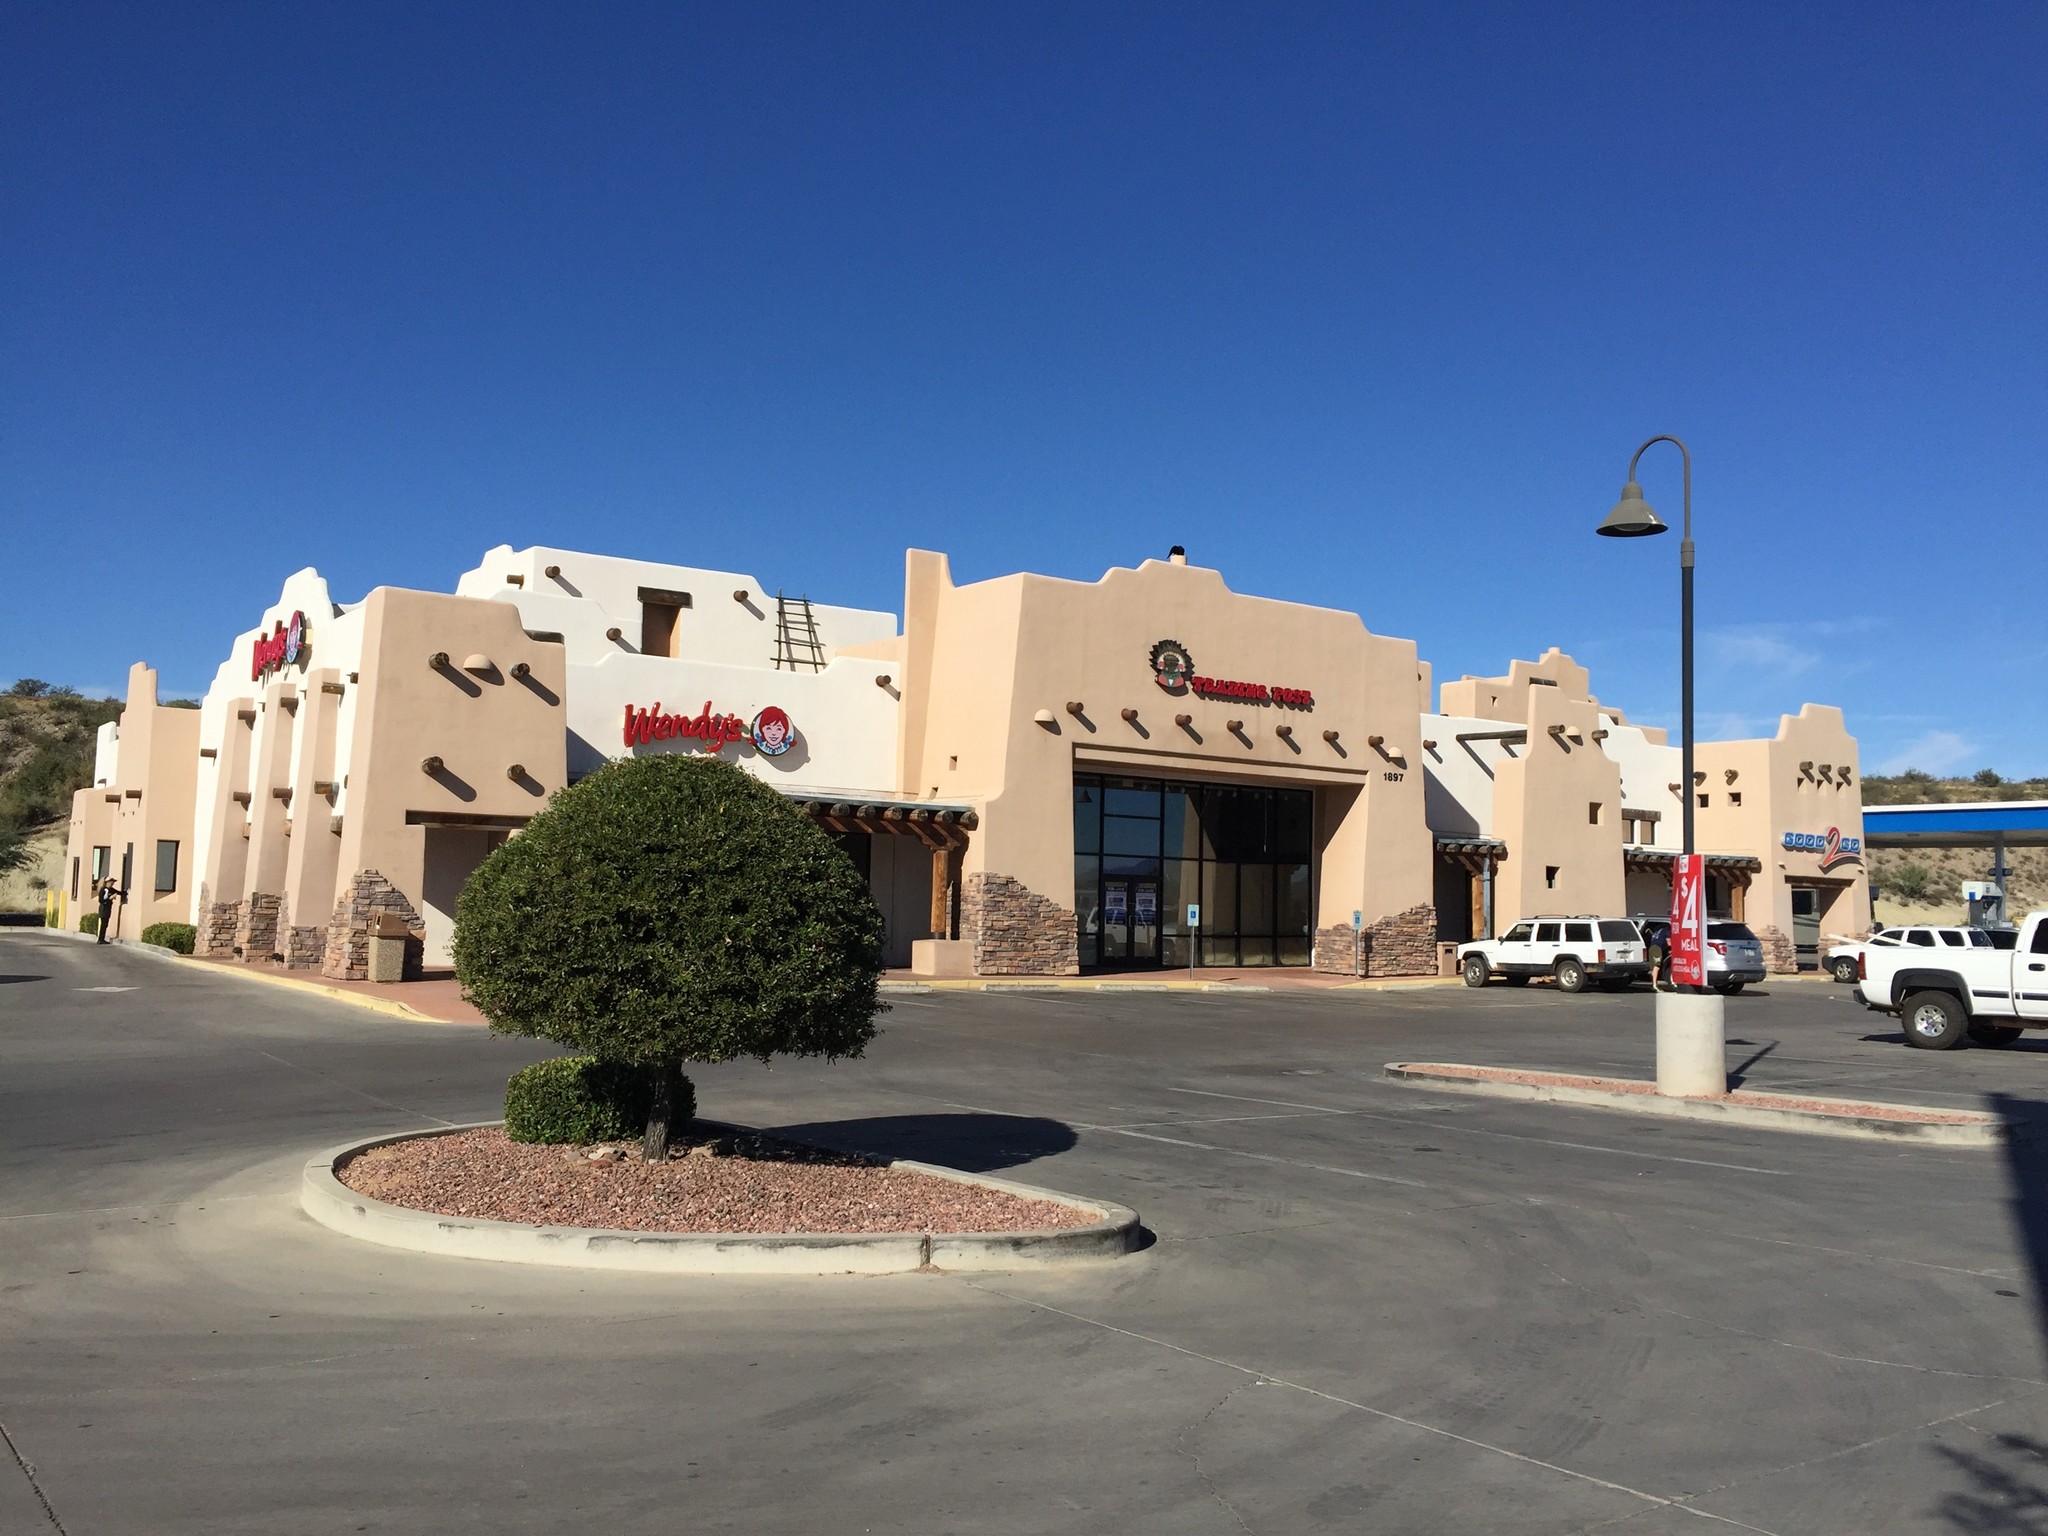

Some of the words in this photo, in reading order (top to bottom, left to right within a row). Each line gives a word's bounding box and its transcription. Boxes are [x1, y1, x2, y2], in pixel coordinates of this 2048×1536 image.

[1191, 676, 1267, 700] TRADING
[1271, 687, 1311, 704] POST
[623, 700, 742, 753] Wendy's
[1383, 772, 1404, 782] 1897
[1784, 832, 1825, 848] GOOD
[1822, 826, 1854, 867] 2
[1841, 838, 1860, 851] GO
[1681, 939, 1699, 951] MEAL
